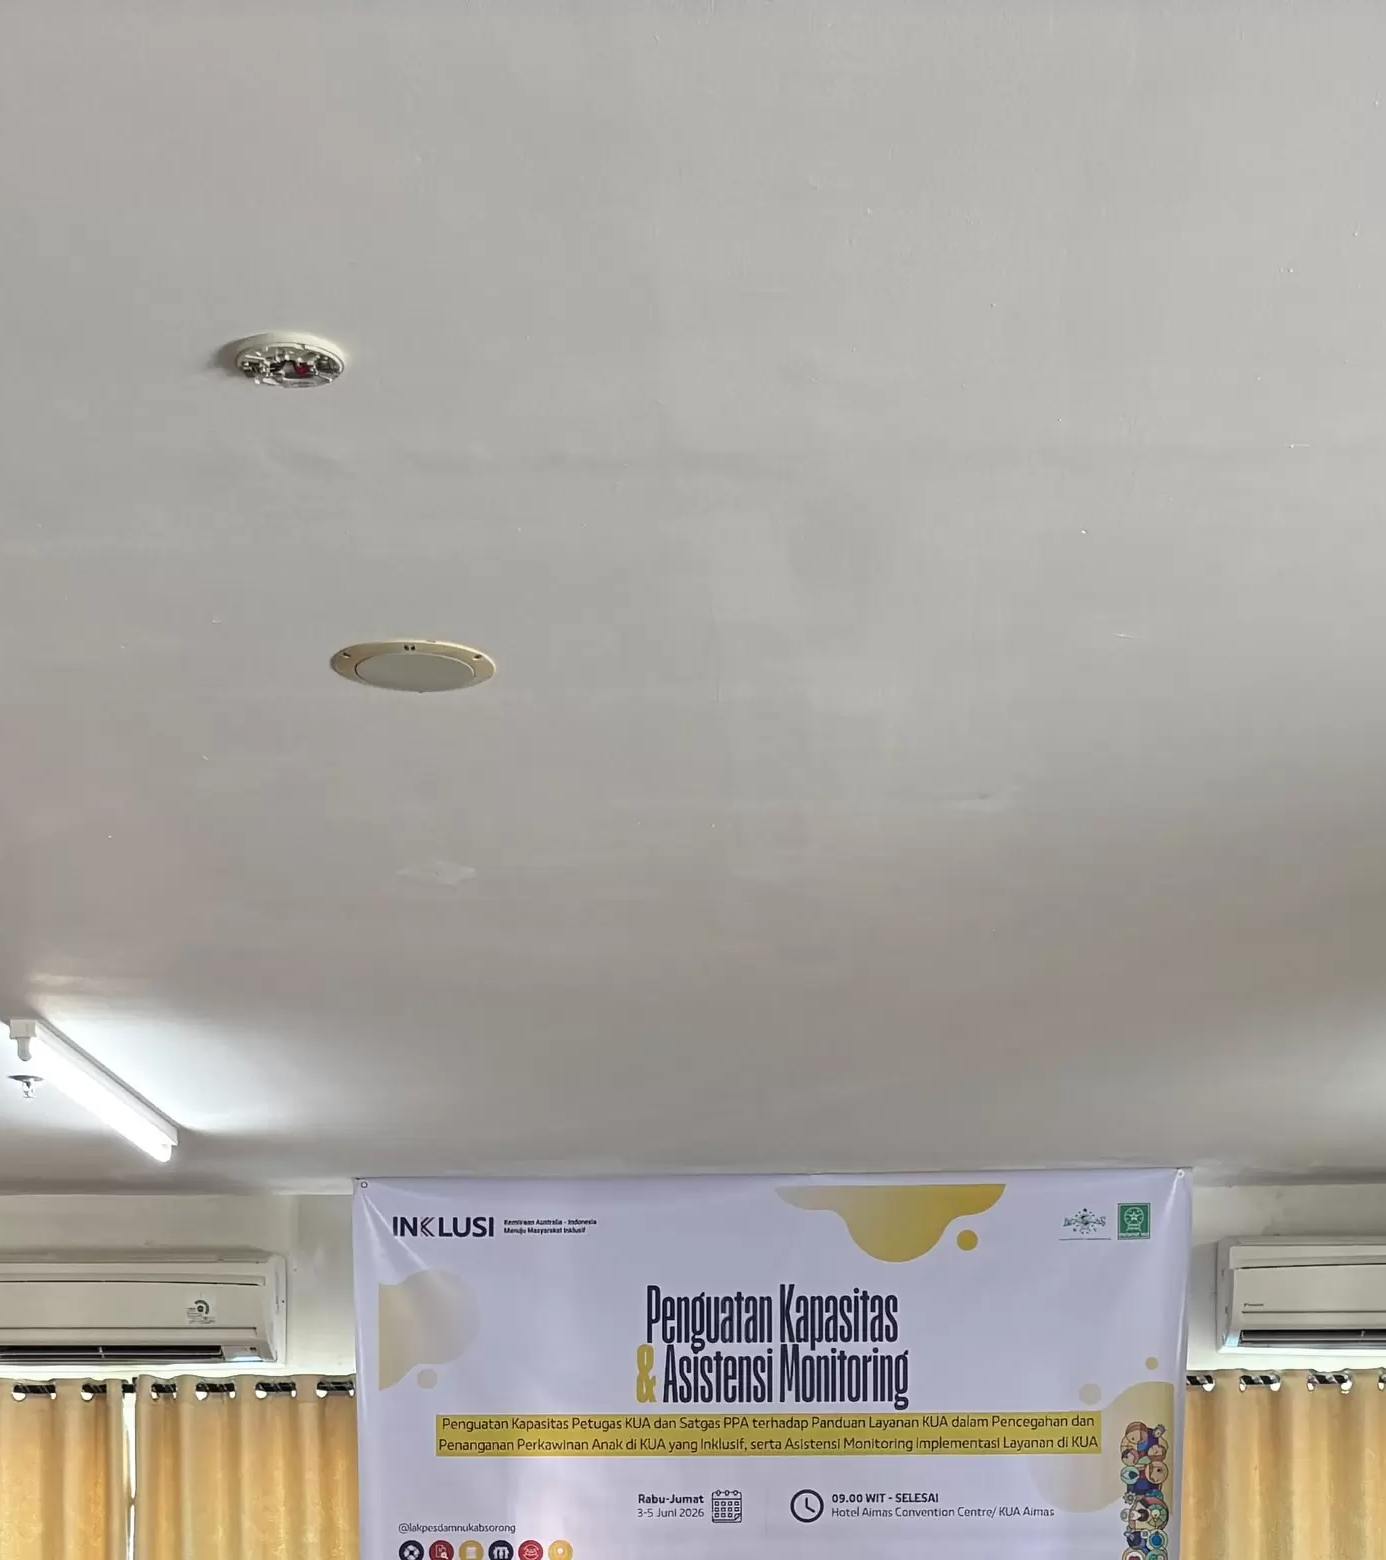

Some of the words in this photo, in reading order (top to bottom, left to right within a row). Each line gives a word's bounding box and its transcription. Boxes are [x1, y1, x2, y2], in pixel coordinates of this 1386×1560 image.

[393, 1216, 494, 1237] INKLUSI
[647, 1284, 773, 1355] Penguatan
[779, 1283, 899, 1351] Kapasitas
[636, 1343, 658, 1404] &
[662, 1344, 773, 1403] Asistensi
[779, 1343, 909, 1411] Monitoring
[442, 1417, 509, 1433] Penguatan
[511, 1417, 569, 1431] Kapasitas
[572, 1417, 622, 1432] Petugas
[625, 1417, 651, 1429] KUA
[653, 1417, 677, 1429] dan
[679, 1417, 721, 1432] Satgas
[723, 1417, 749, 1429] PPA
[752, 1416, 809, 1431] terhadap
[811, 1416, 865, 1428] Panduan
[868, 1416, 919, 1431] Layanan
[922, 1415, 948, 1428] KUA
[951, 1415, 989, 1428] dalam
[992, 1415, 1068, 1431] Pencegahan
[1071, 1415, 1095, 1427] dan
[438, 1438, 514, 1453] Penanganan
[517, 1438, 589, 1450] Perkawinan
[591, 1438, 623, 1450] Anak
[625, 1438, 637, 1450] di
[640, 1438, 666, 1450] KUA
[668, 1440, 698, 1453] yang
[701, 1438, 748, 1452] Inklusif,
[750, 1438, 782, 1450] serta
[784, 1437, 841, 1450] Asistensi
[843, 1437, 913, 1453] Monitoring
[916, 1437, 1000, 1452] Implementasi
[1003, 1437, 1054, 1452] Layanan
[1057, 1437, 1069, 1449] di
[1071, 1437, 1099, 1448] KUA
[638, 1494, 705, 1504] Rabu-Jumat
[831, 1493, 863, 1503] 09.00
[865, 1493, 886, 1503] WIT
[895, 1493, 939, 1503] SELESAI
[637, 1508, 653, 1518] 3-5
[656, 1508, 677, 1518] Juni
[680, 1508, 705, 1518] 2026
[831, 1507, 860, 1517] Hotel
[862, 1507, 893, 1517] Aimas
[895, 1507, 955, 1517] Convention
[957, 1507, 997, 1518] Centre/
[999, 1507, 1021, 1517] KUA
[1023, 1507, 1055, 1517] Aimas
[398, 1522, 516, 1534] @lakpesdamnukabsorong
